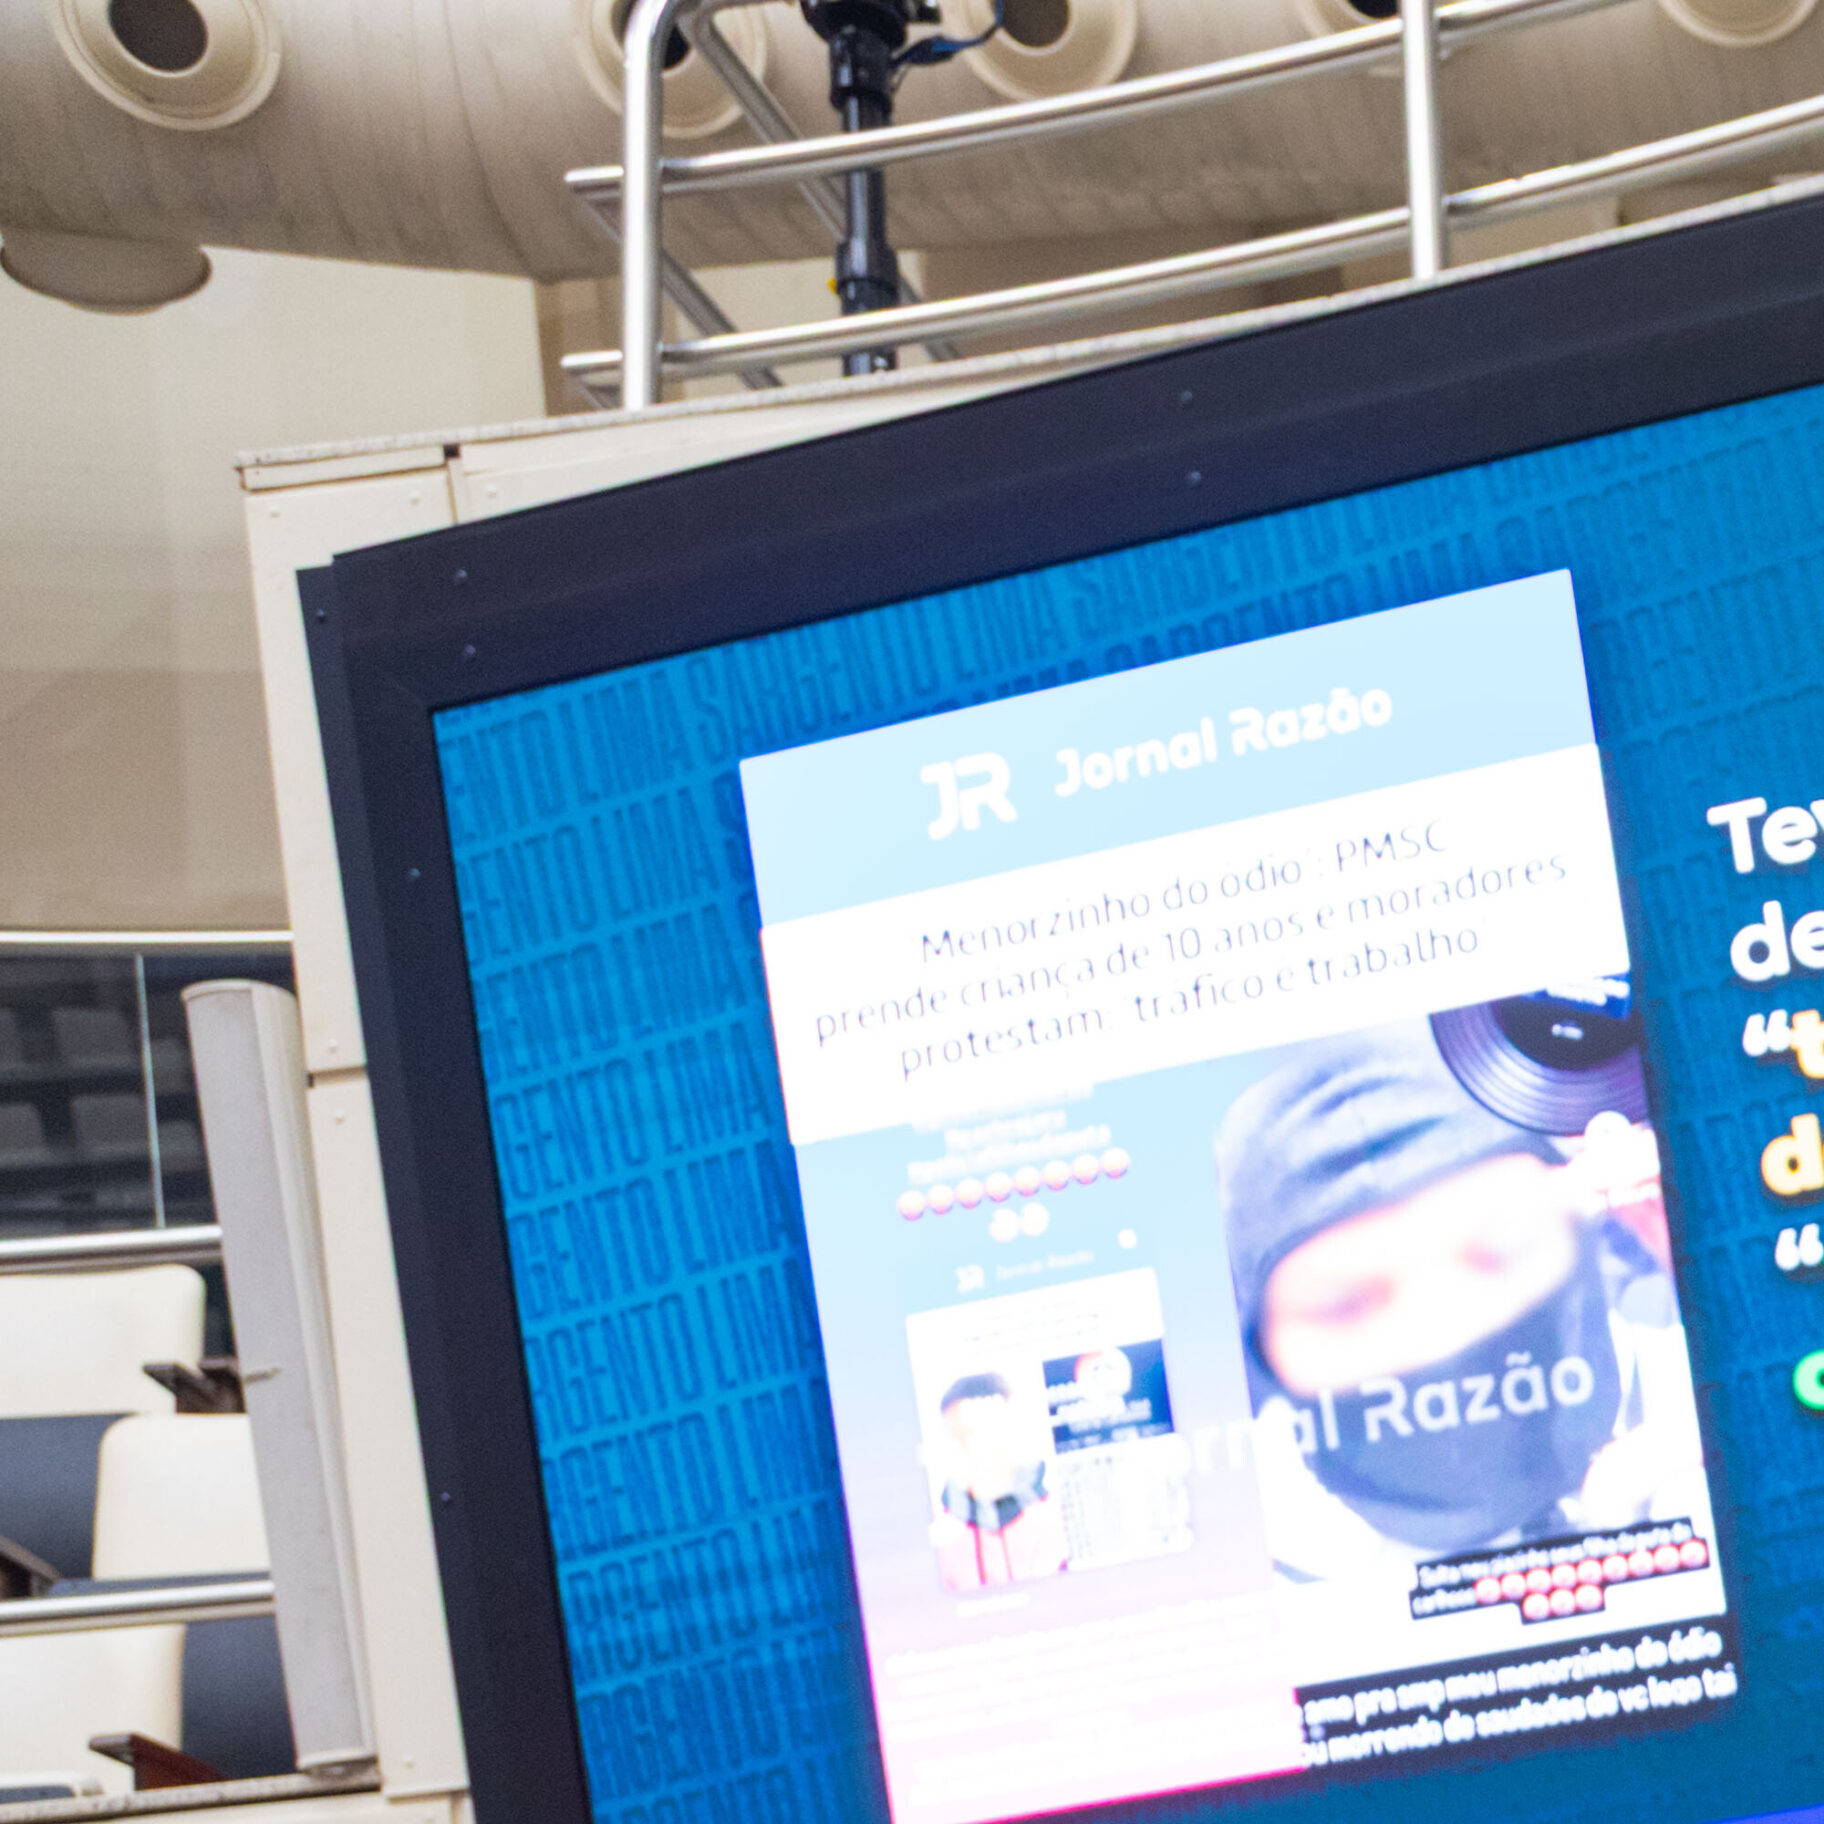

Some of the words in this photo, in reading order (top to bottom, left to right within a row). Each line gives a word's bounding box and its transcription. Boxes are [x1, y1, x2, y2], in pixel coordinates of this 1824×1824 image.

[1055, 717, 1217, 797] Jornal
[1229, 686, 1393, 755] Razão
[920, 752, 1018, 840] JR
[1162, 877, 1209, 911] do
[1335, 822, 1448, 873] PMSC
[815, 985, 947, 1049] prende
[960, 957, 1096, 1006] criança
[1106, 942, 1151, 975] de
[1162, 927, 1202, 961] 10
[1213, 913, 1305, 952] anos
[1314, 906, 1336, 931] e
[1346, 856, 1567, 923] moradores
[1276, 968, 1296, 992] e
[1358, 1350, 1596, 1444] Razão
